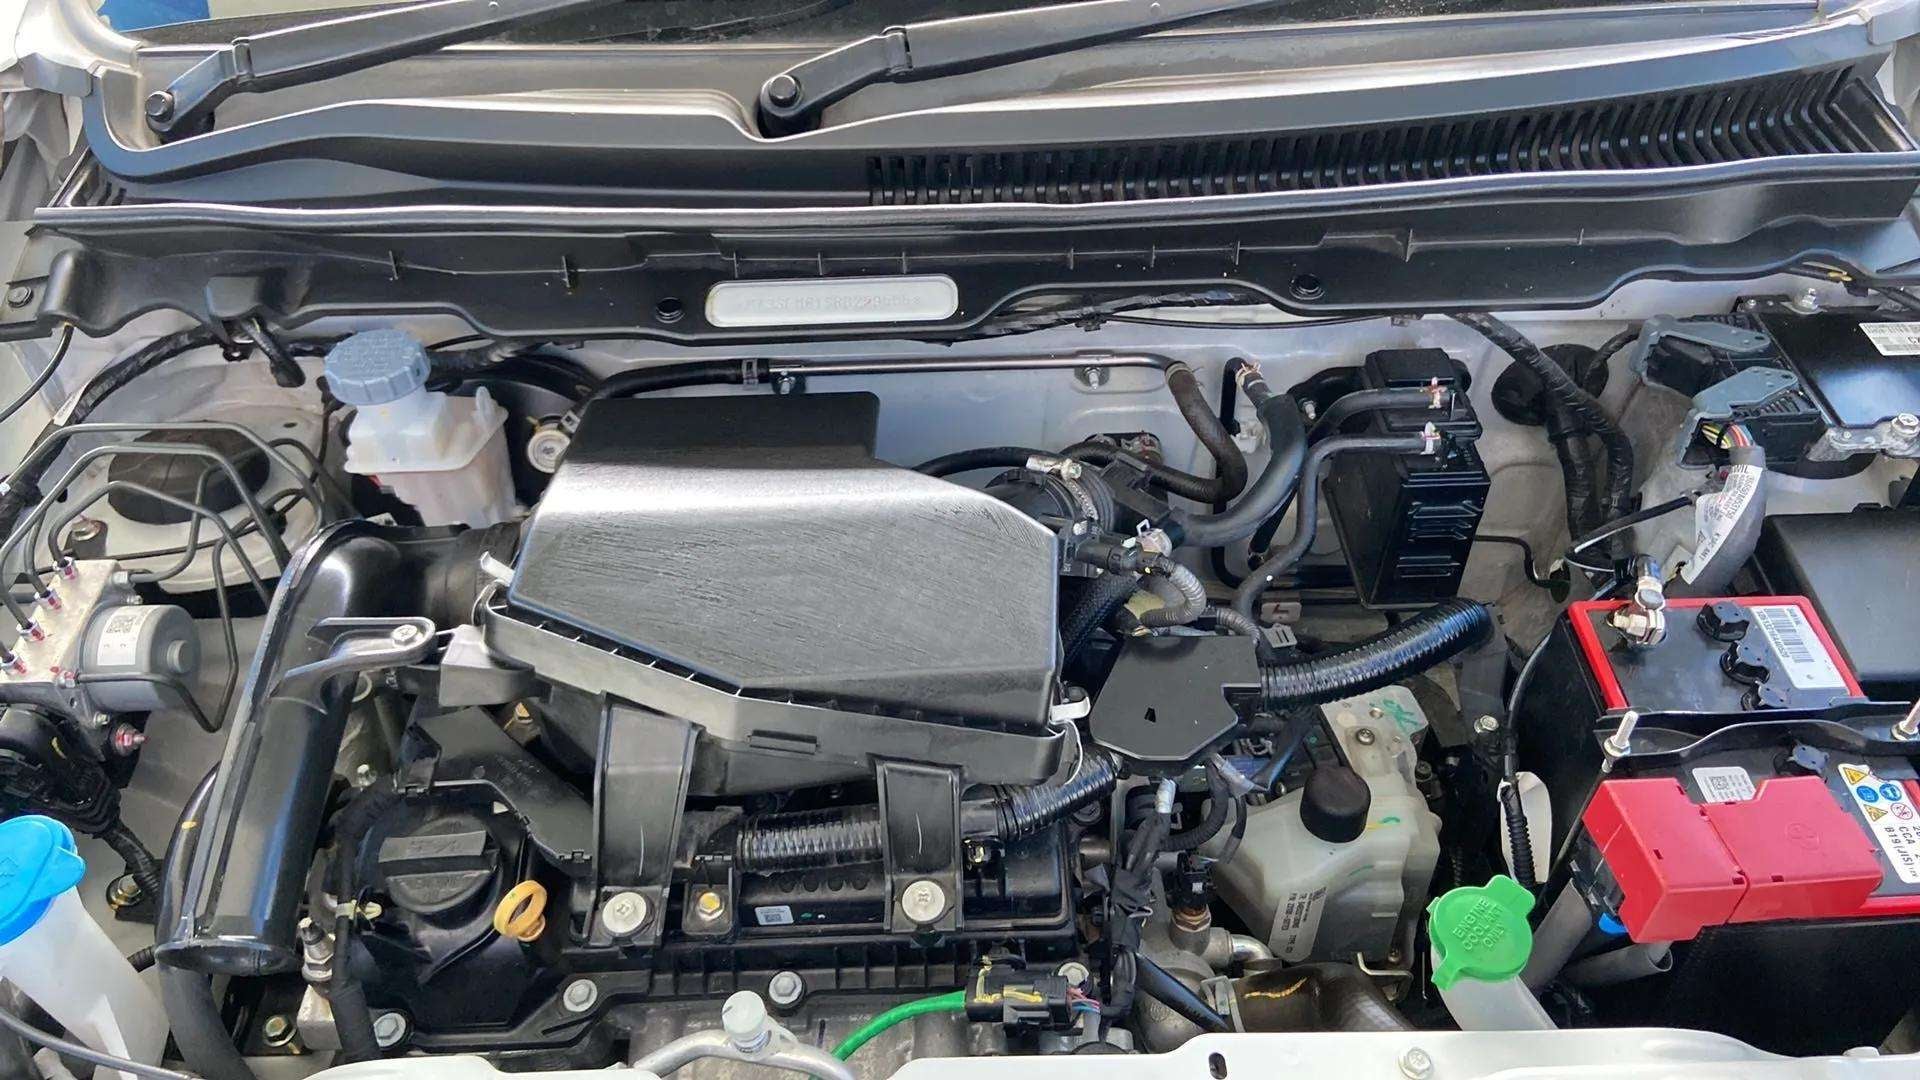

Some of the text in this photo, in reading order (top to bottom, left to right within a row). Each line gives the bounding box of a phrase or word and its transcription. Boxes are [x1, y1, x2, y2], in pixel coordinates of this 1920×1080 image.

[1884, 826, 1914, 866] B19(JIS)
[1898, 826, 1916, 844] CCA
[1453, 896, 1489, 938] ENGINE
[1462, 903, 1504, 950] COOLANT
